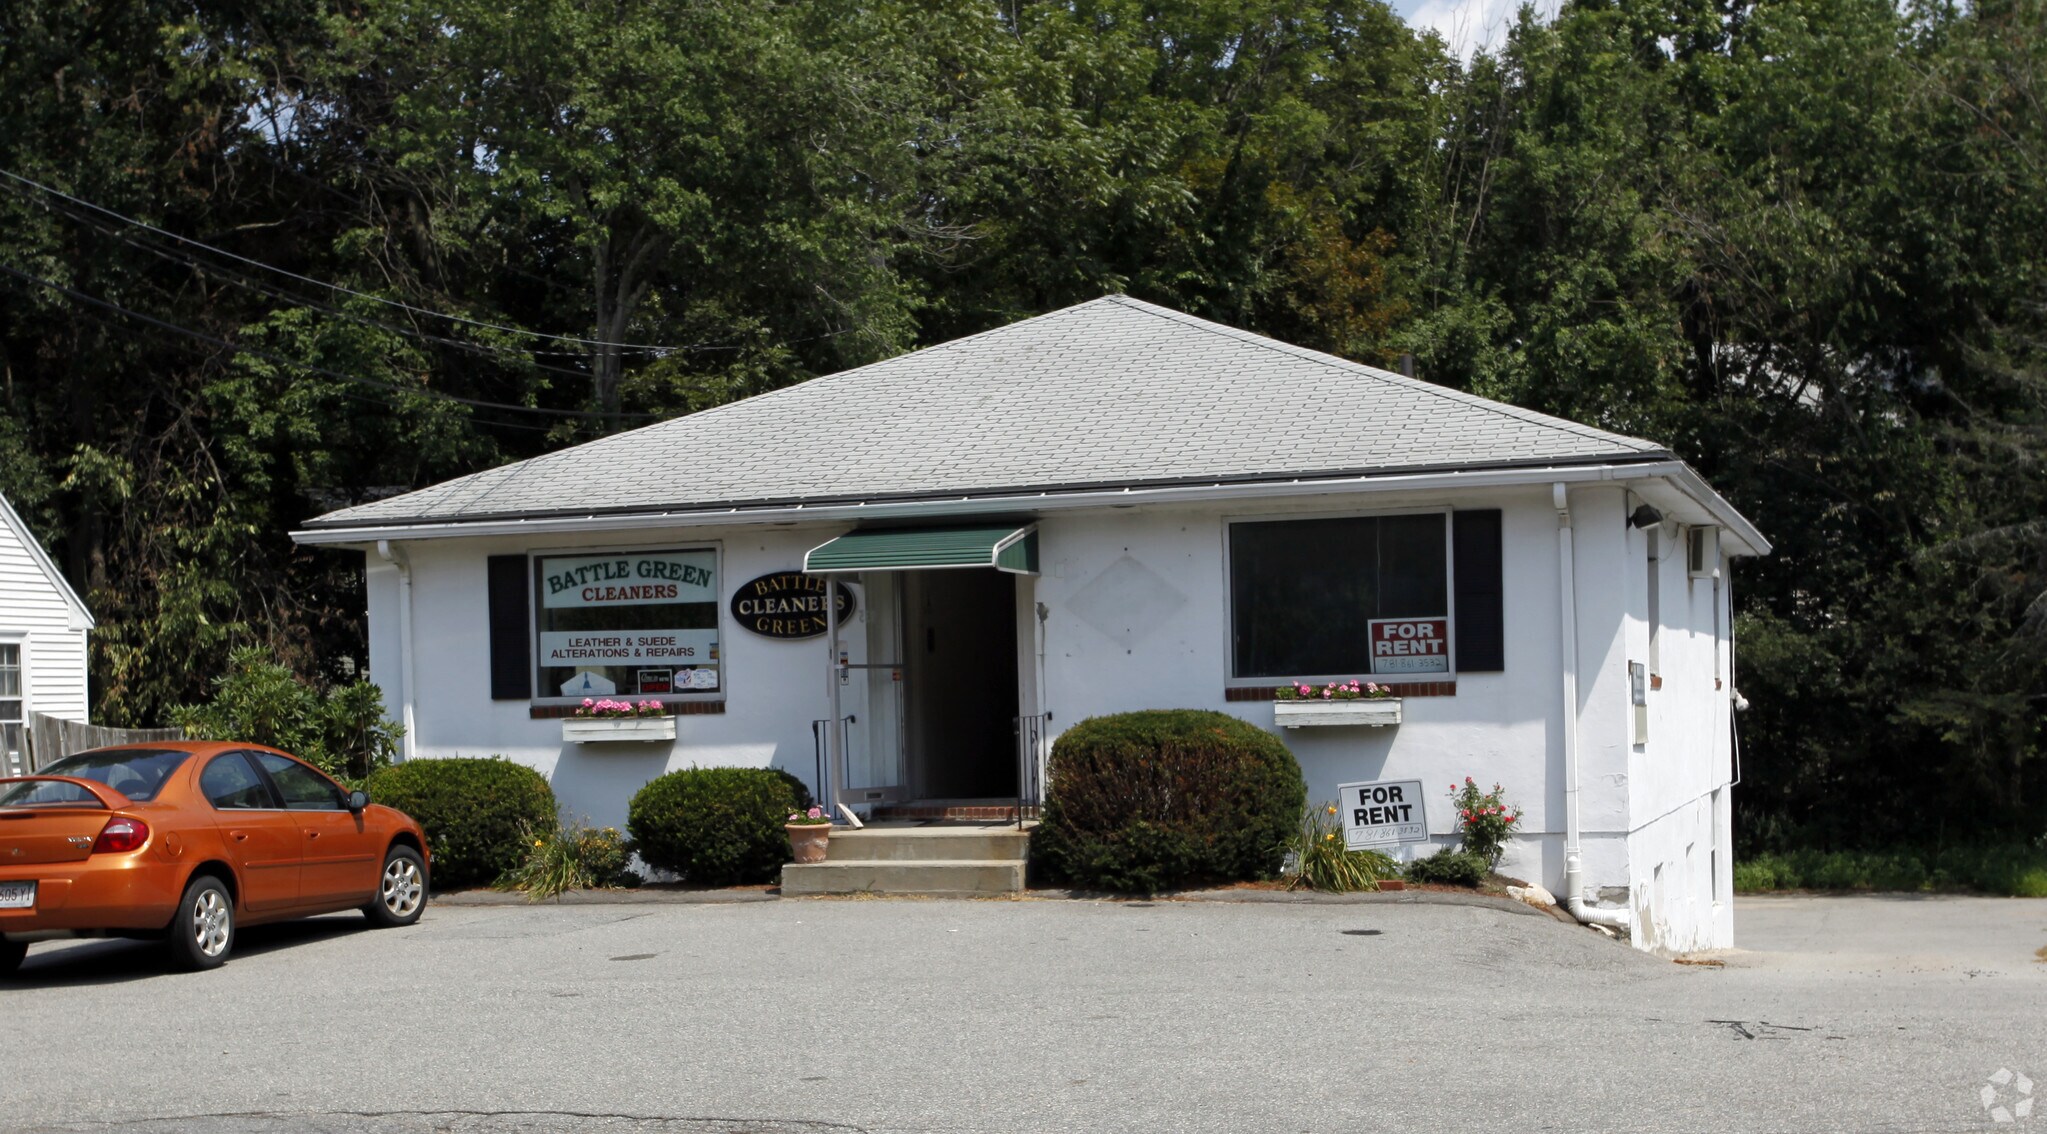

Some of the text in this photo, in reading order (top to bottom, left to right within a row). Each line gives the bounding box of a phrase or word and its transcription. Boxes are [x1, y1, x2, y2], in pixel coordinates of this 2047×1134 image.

[547, 559, 713, 594] BATTLE GREEN
[755, 575, 826, 596] BATTLE
[581, 584, 679, 602] CLEANERS
[756, 613, 827, 635] GREEN
[1383, 623, 1434, 640] FOR
[568, 636, 676, 648] LEATHER & SUEDE
[1375, 639, 1443, 655] RENT
[550, 647, 695, 659] ALTERATIONS & REPAIRS
[1359, 786, 1404, 806] FOR
[1353, 804, 1412, 826] RENT
